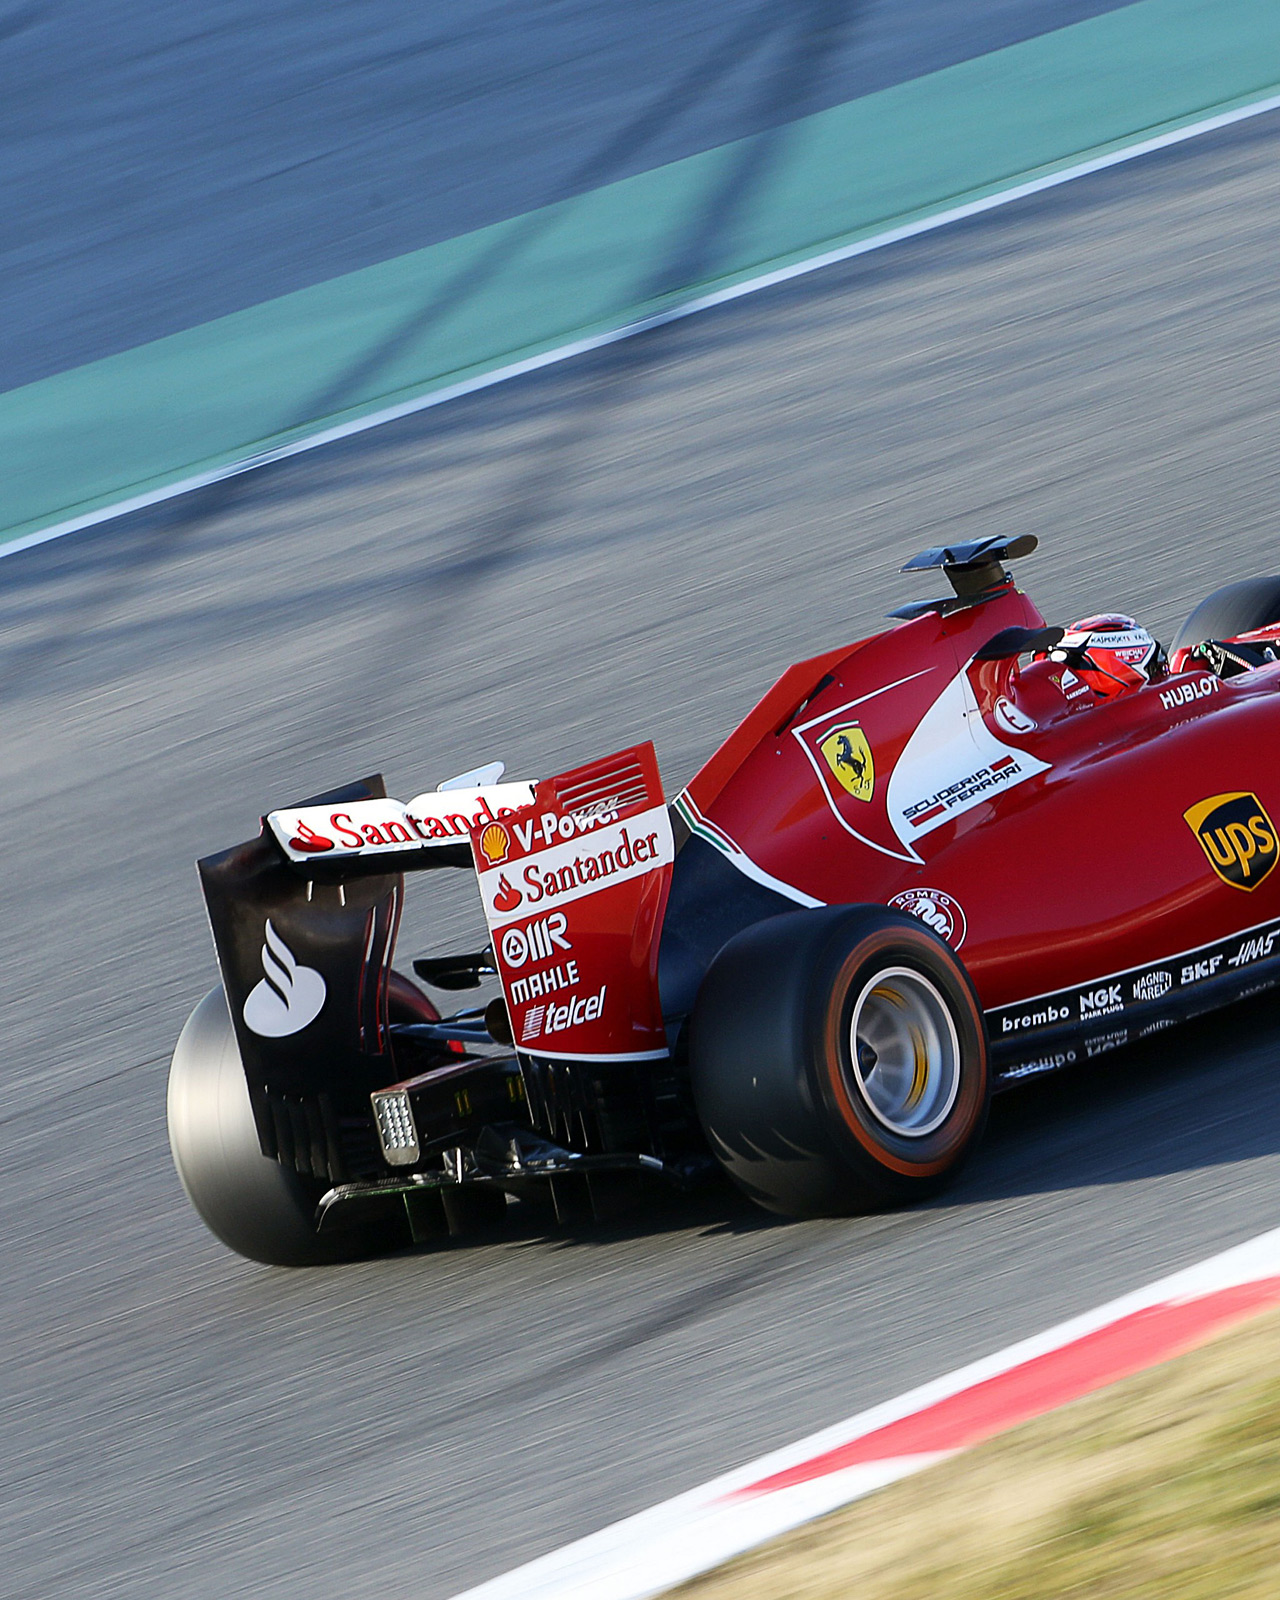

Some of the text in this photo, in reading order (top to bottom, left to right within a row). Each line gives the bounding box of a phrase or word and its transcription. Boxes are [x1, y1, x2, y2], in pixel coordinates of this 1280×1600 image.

[1159, 674, 1220, 710] HUBLOT
[902, 768, 991, 819] SCUDERIA
[945, 763, 1022, 808] FERRARI
[523, 828, 660, 903] Santander
[895, 891, 950, 906] ROMEO
[510, 960, 580, 1006] MAHLE
[1133, 971, 1172, 996] MAGNETI
[1180, 954, 1223, 985] SKF
[1079, 983, 1123, 1013] NGK
[1133, 978, 1172, 1000] MARELLI
[544, 985, 607, 1035] telcel
[1002, 1007, 1070, 1033] brembo
[1080, 1003, 1125, 1021] SPARK PLUGS
